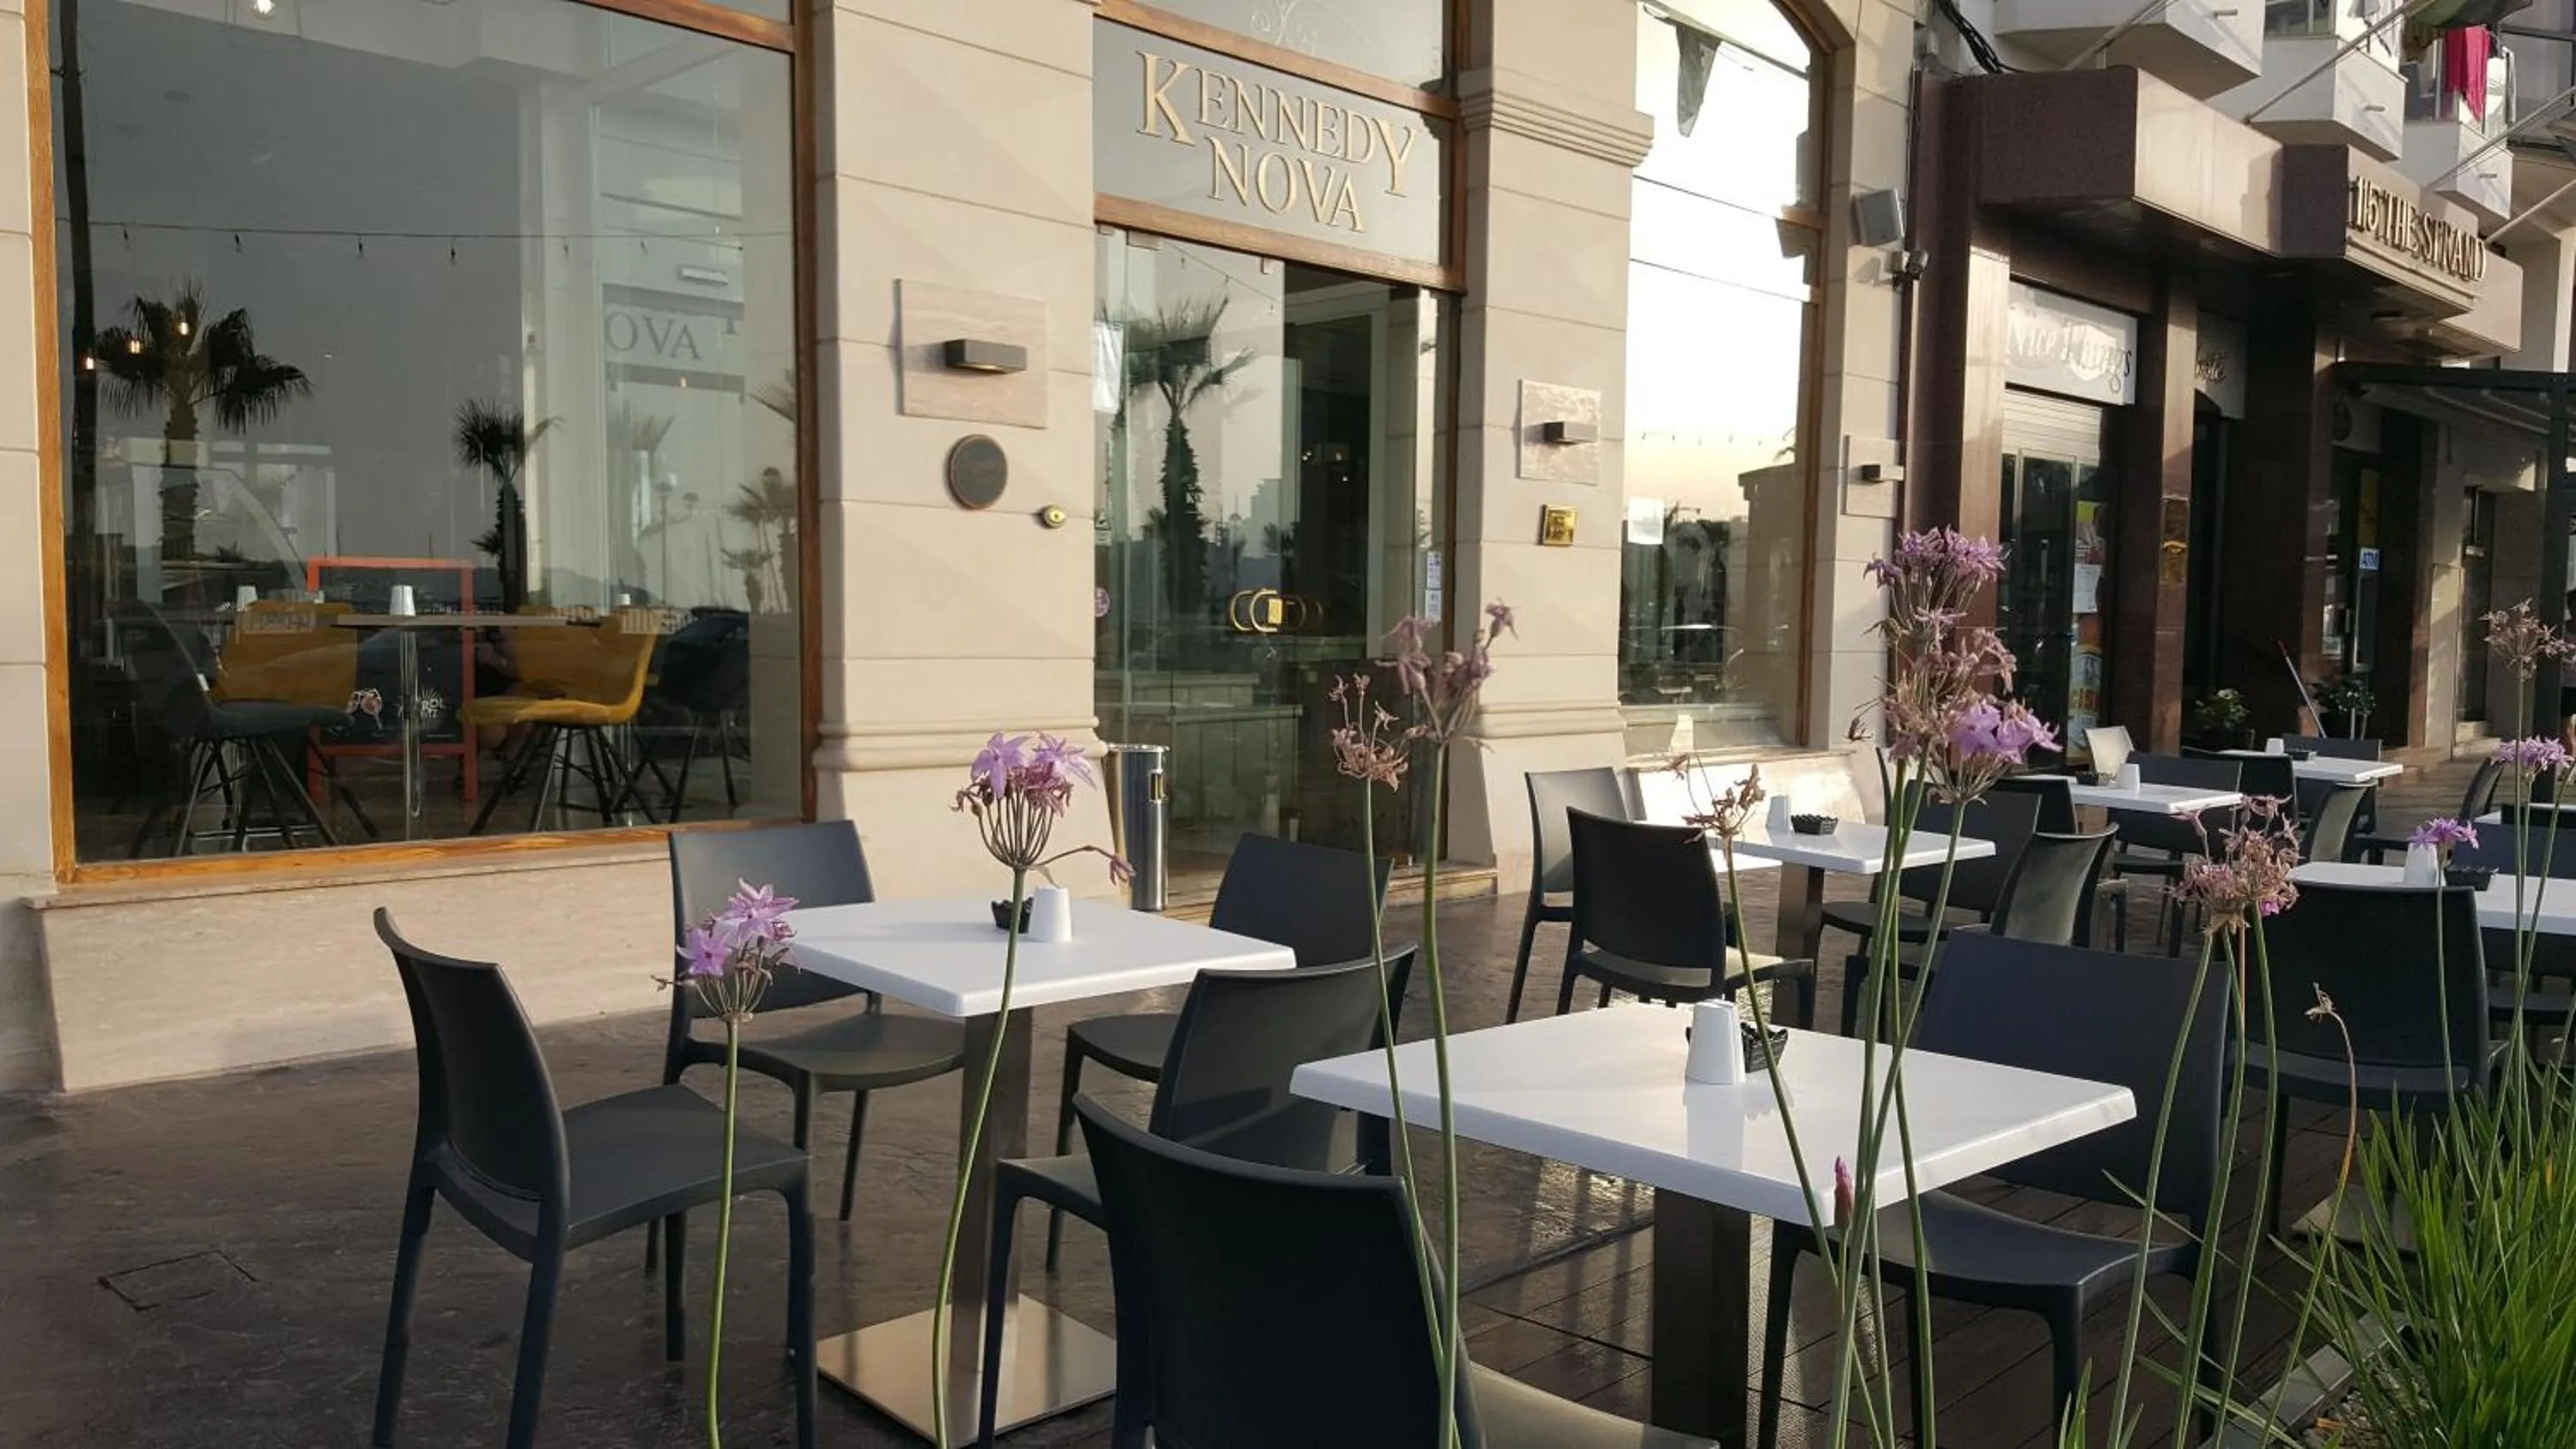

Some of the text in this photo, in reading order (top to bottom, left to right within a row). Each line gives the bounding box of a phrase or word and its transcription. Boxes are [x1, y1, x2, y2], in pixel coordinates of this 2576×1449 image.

[1135, 50, 1418, 197] KENNEDY
[1205, 136, 1367, 233] NOVA
[2384, 190, 2420, 253] THE
[2421, 212, 2487, 281] STRAND
[605, 312, 702, 361] OVA
